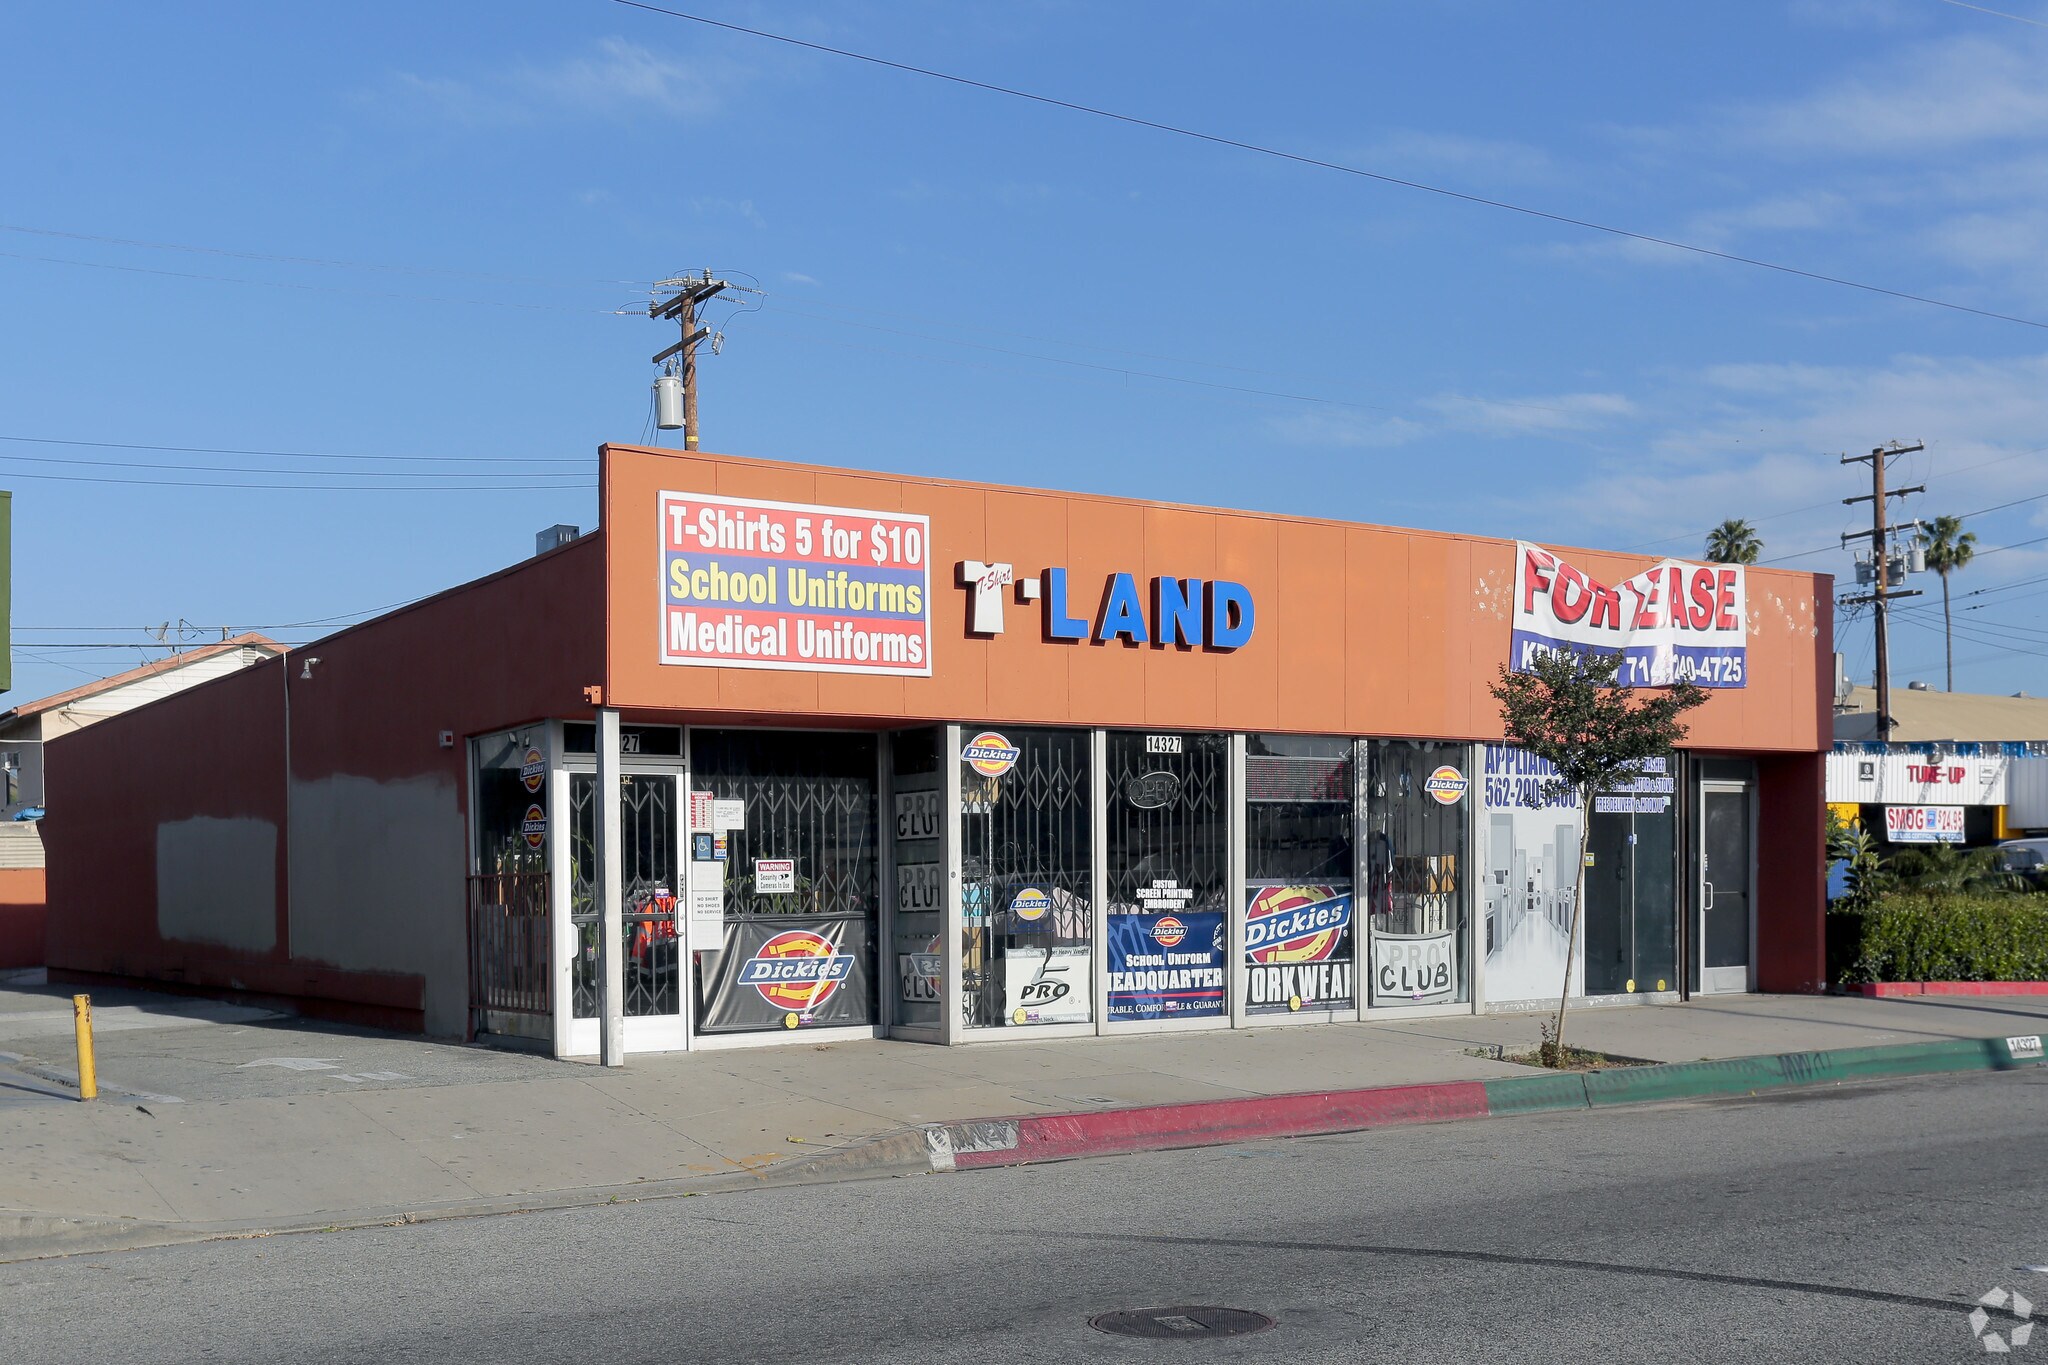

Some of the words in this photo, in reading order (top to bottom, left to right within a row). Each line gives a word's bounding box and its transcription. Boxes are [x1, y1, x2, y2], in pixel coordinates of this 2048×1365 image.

[668, 504, 787, 554] T-Shirts
[795, 517, 813, 557] 5
[821, 518, 862, 560] for
[870, 520, 922, 566] $10
[669, 558, 777, 605] School
[787, 567, 922, 615] Uniforms
[976, 567, 1011, 595] T-Shirt
[1523, 548, 1621, 632] FOR
[670, 611, 787, 657] Medical
[797, 619, 923, 664] Uniforms
[1147, 736, 1181, 753] 14327
[968, 748, 1014, 760] Dickies
[522, 762, 545, 777] Dickies
[1907, 764, 1966, 785] TUNE-UP
[1430, 780, 1464, 790] Dickies
[1656, 777, 1674, 793] STOVE
[1595, 797, 1610, 812] FREE
[1609, 797, 1635, 812] DELIVERY
[897, 812, 940, 837] CLU
[1887, 807, 1924, 830] SMOG
[523, 822, 546, 833] Dickies
[759, 863, 790, 871] WARNING
[760, 873, 778, 881] Security
[1152, 879, 1178, 889] CUSTOM
[899, 884, 940, 909] CLU
[1136, 888, 1161, 899] SCREEN
[1162, 888, 1194, 899] PRINTING
[1014, 900, 1048, 908] Dickies
[1143, 898, 1186, 909] EMBROIDERY
[1246, 904, 1344, 946] Dickies
[1058, 948, 1072, 956] Heavy
[1126, 953, 1165, 967] SCHOOL
[1167, 952, 1212, 966] UNIFORM
[1388, 942, 1441, 971] PRO
[749, 960, 844, 980] Dickies
[1380, 961, 1449, 992] CLUB
[1020, 982, 1070, 1000] PRO
[1186, 1002, 1192, 1010] &
[2010, 1037, 2038, 1053] 14327
